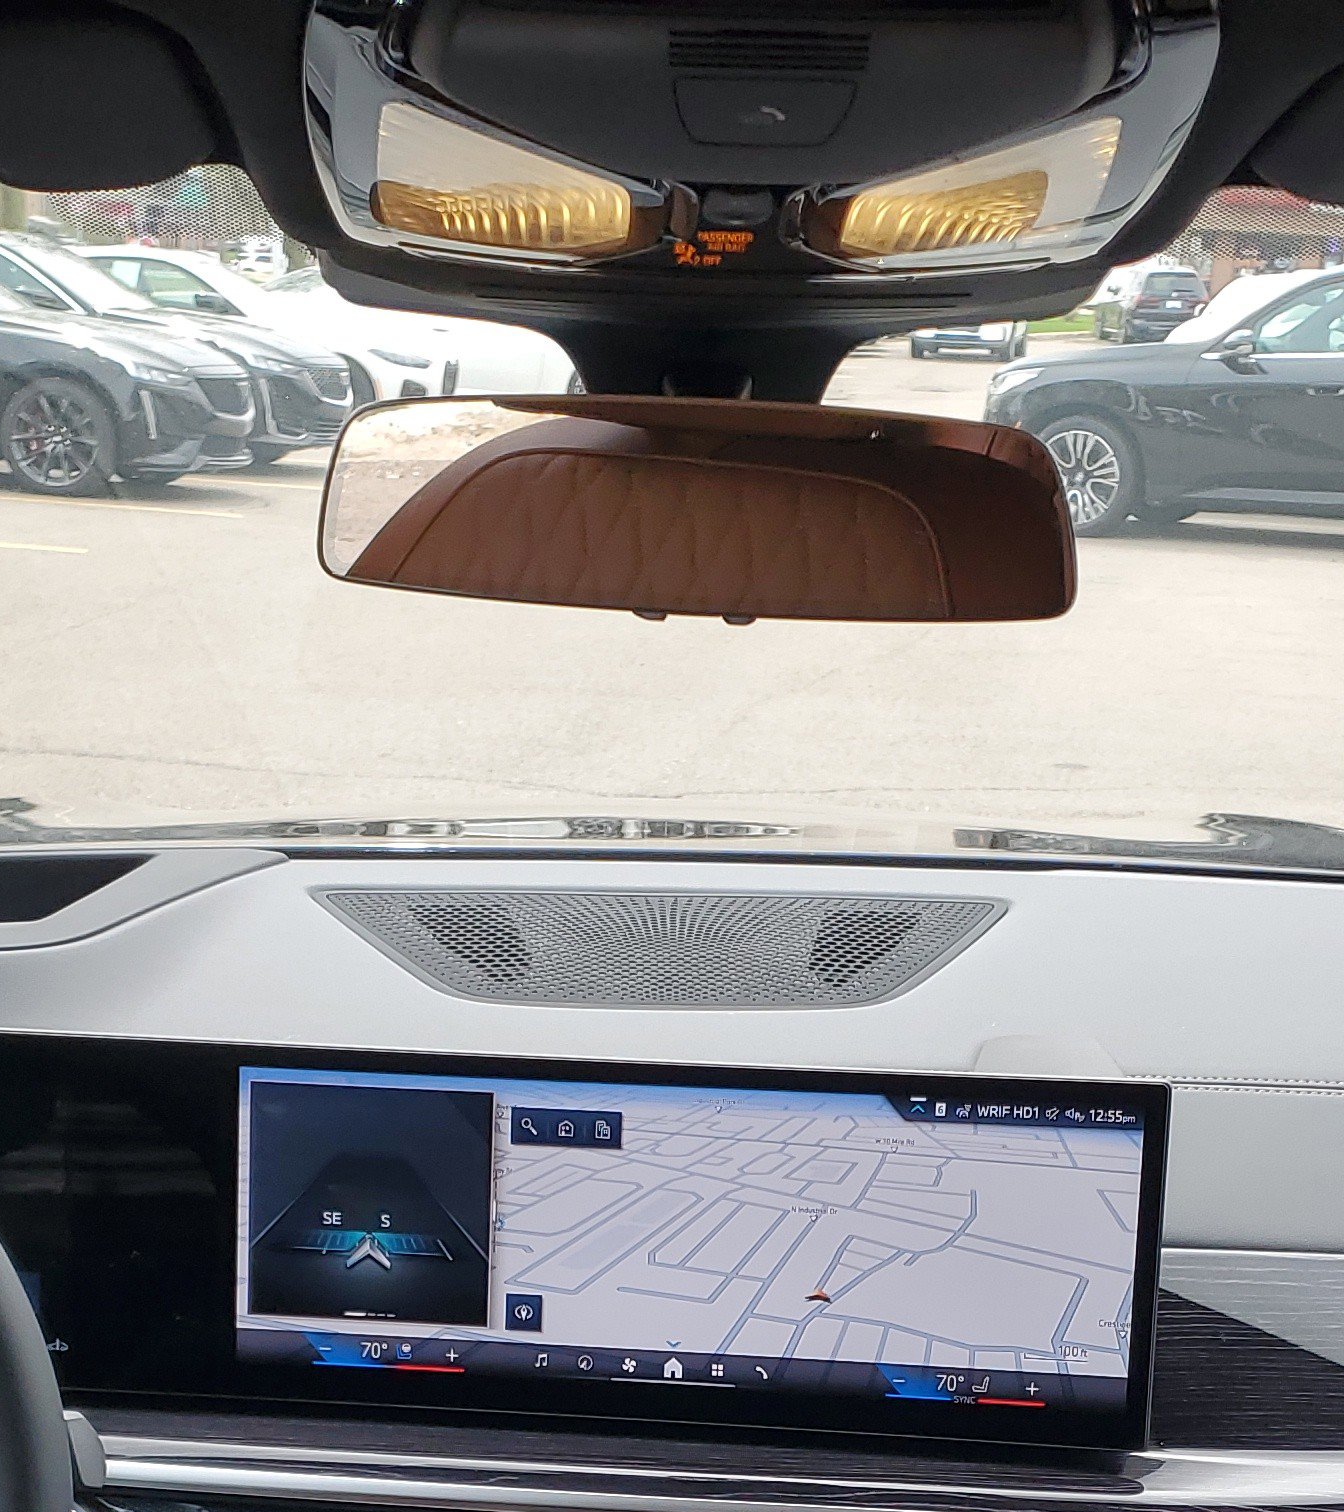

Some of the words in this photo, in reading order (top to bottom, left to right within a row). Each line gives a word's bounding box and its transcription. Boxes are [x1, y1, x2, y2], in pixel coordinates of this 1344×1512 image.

[977, 1105, 1010, 1118] WRIF
[1013, 1106, 1039, 1119] HD1
[322, 1211, 342, 1225] SE
[380, 1214, 391, 1228] S
[1058, 1345, 1079, 1358] 100
[1080, 1349, 1088, 1358] ft
[953, 1396, 976, 1404] SYNC
